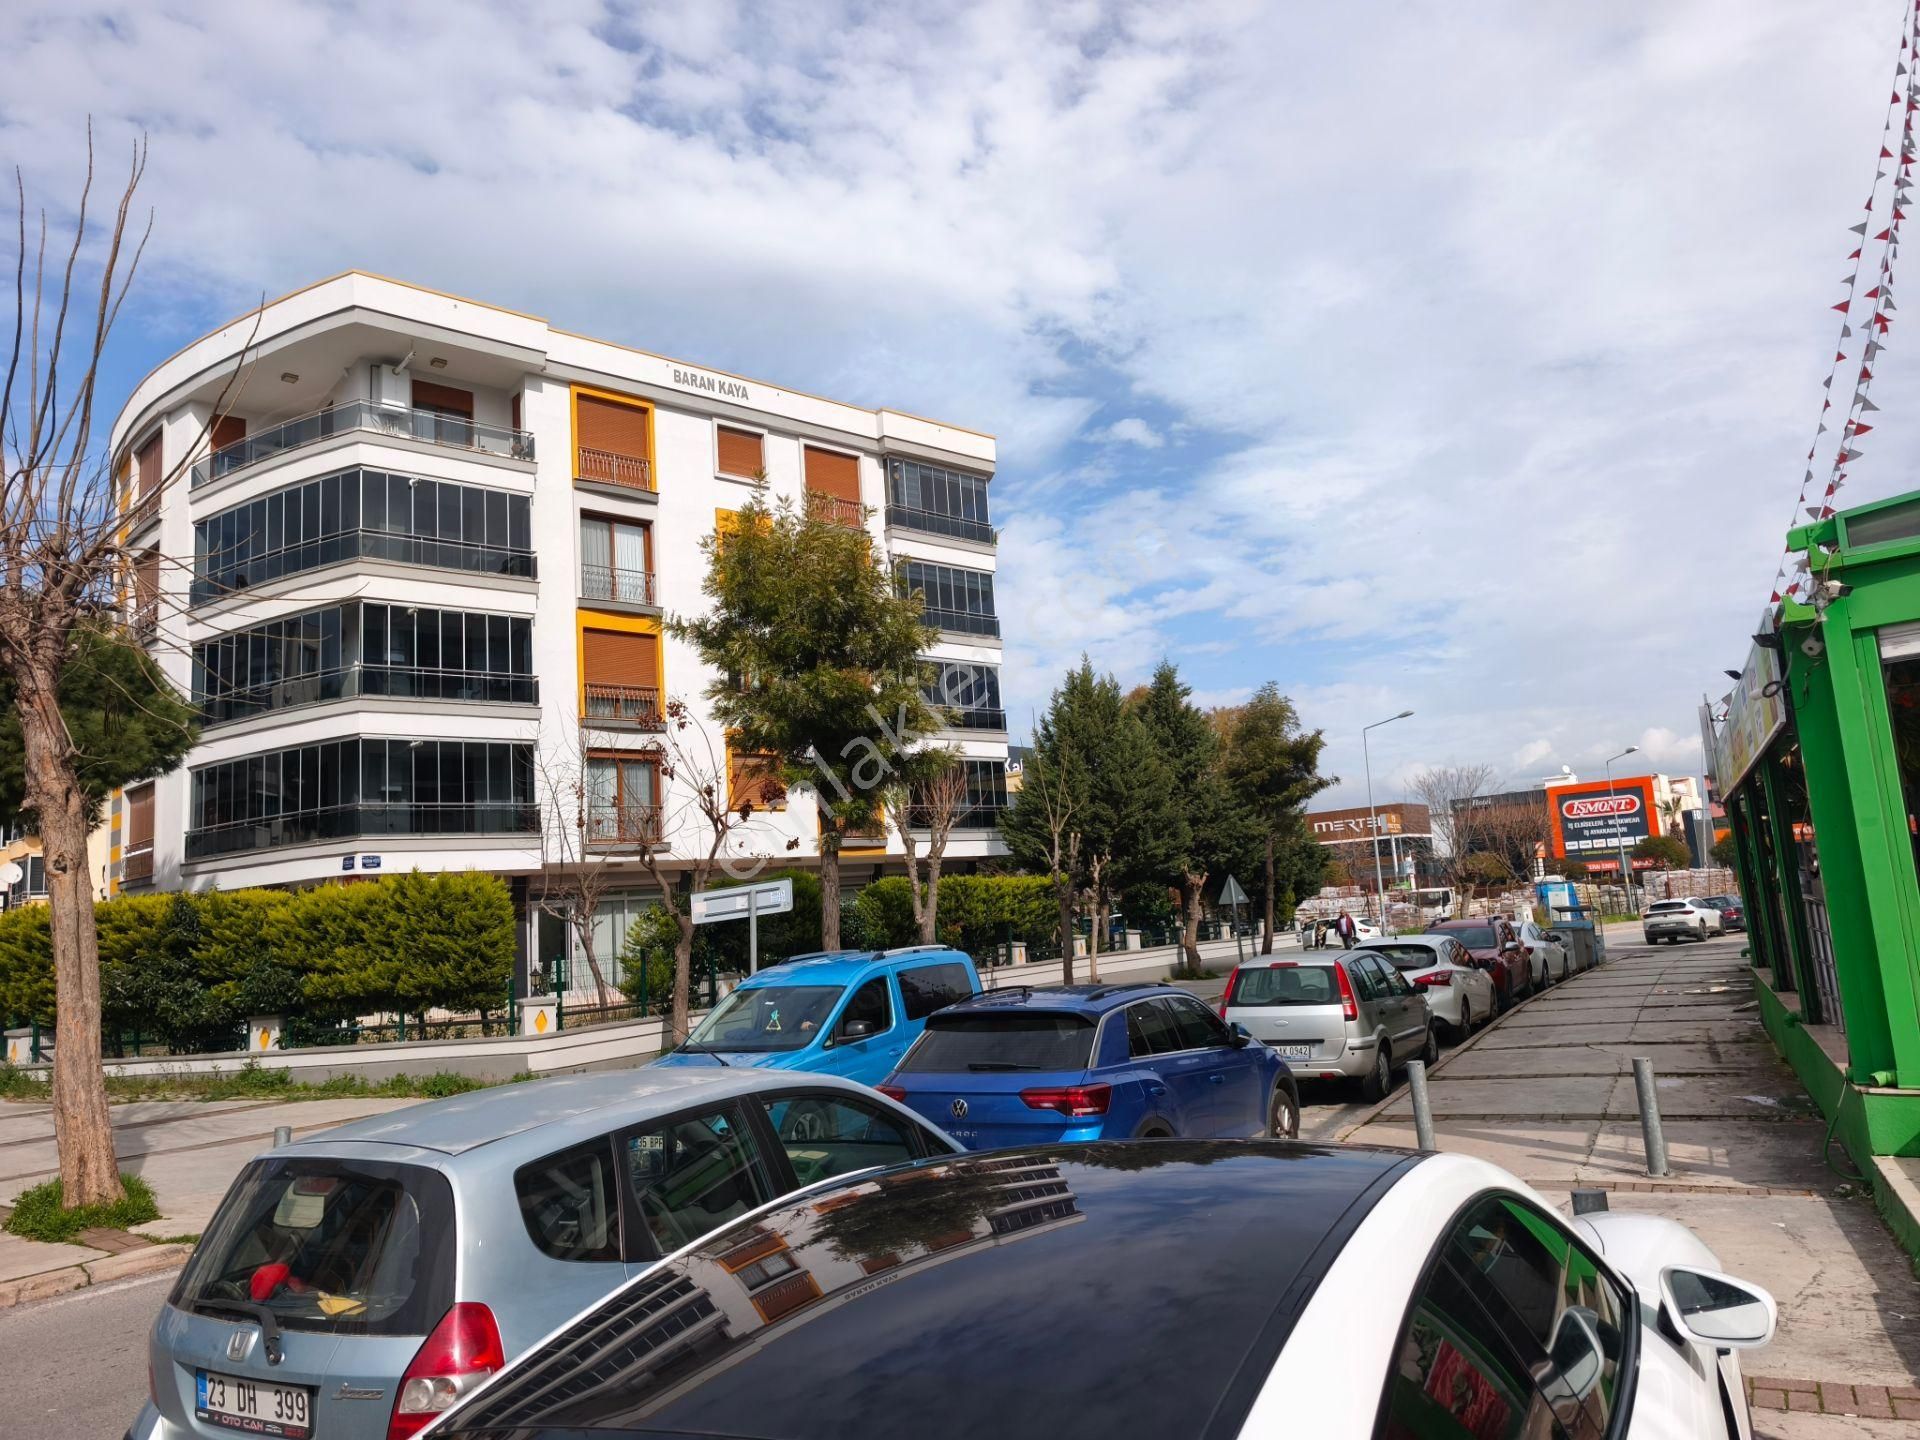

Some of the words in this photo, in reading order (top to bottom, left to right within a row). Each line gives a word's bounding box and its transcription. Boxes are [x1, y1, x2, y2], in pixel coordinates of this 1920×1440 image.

[673, 369, 715, 392] BARAN
[718, 380, 749, 400] KAYA
[1289, 1046, 1308, 1056] 0942
[208, 1377, 226, 1408] 23
[237, 1382, 257, 1415] DH
[274, 1388, 306, 1423] 399
[221, 1415, 241, 1427] OTO
